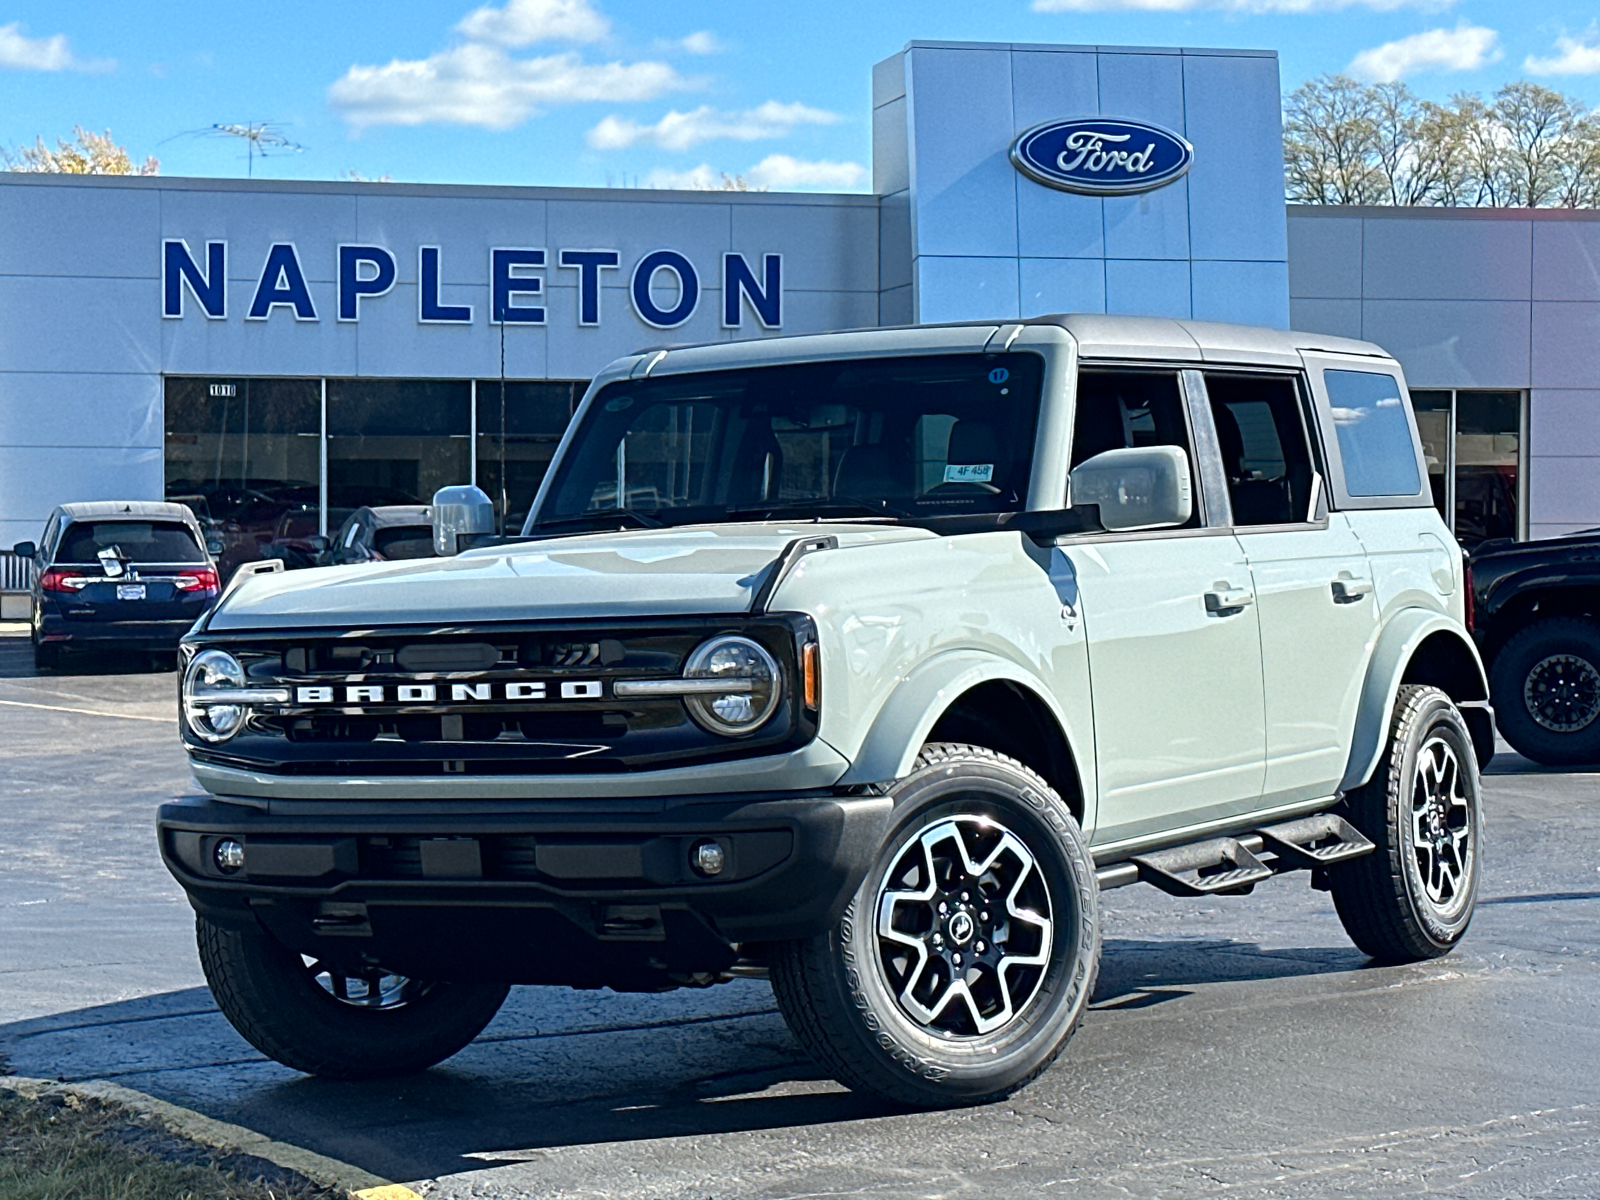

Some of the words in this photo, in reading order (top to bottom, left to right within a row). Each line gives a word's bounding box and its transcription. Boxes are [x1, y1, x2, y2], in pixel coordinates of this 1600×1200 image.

[1056, 131, 1156, 173] Ford
[160, 237, 784, 330] NAPLETON
[210, 384, 236, 397] 1010
[297, 680, 603, 703] BRONCO
[1019, 786, 1094, 951] DUELER
[840, 897, 952, 1082] BRIDGESTON
